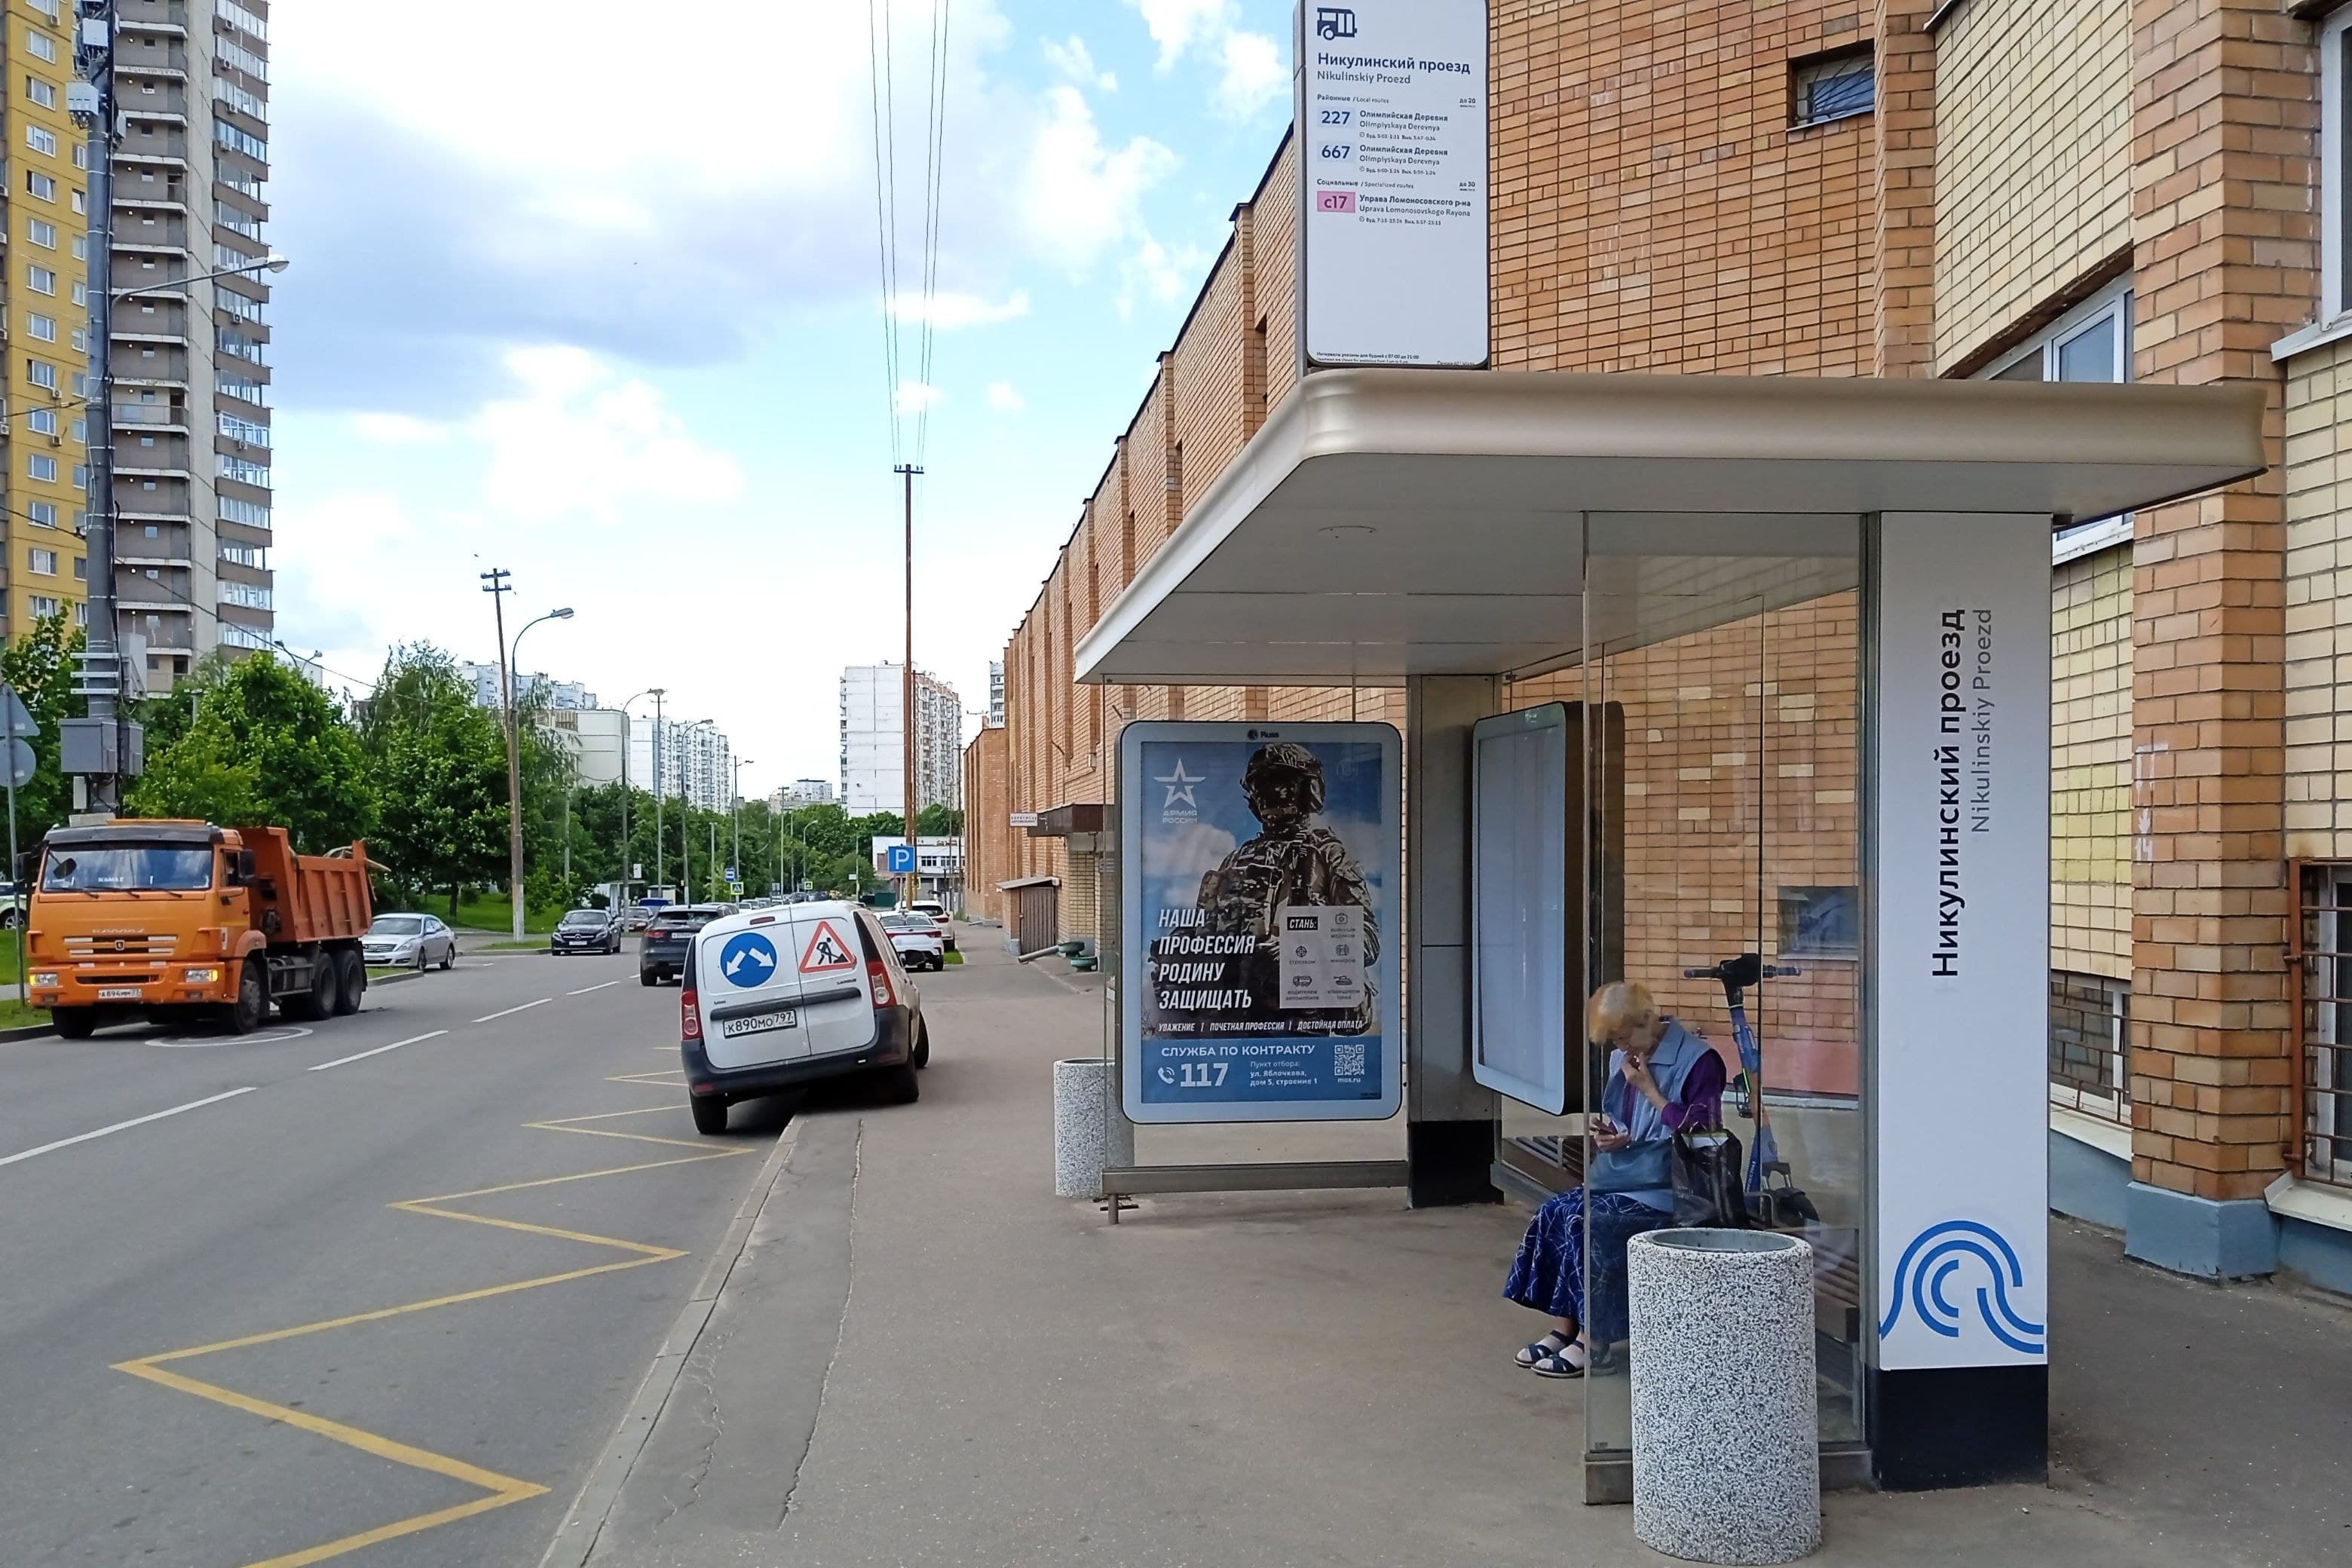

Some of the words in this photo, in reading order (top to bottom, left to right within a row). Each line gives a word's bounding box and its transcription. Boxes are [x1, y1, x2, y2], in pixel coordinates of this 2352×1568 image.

[1318, 52, 1415, 69] Никулинский
[1419, 60, 1471, 75] проезд
[1317, 70, 1374, 84] Nikulinskiy
[1377, 73, 1410, 84] Proezd
[1317, 93, 1351, 102] Районные
[1321, 110, 1351, 124] 227
[1359, 110, 1413, 121] Олимпийская
[1414, 112, 1448, 122] Деревня
[1408, 123, 1441, 132] Derevnya
[1321, 145, 1350, 159] 667
[1359, 145, 1413, 155] Олимпийская
[1414, 147, 1448, 156] Деревня
[1408, 157, 1441, 166] Derevnya
[1317, 179, 1358, 187] Социальные
[1359, 194, 1388, 204] Управа
[1389, 196, 1453, 206] Ломоносовского
[1359, 205, 1384, 213] Uprava
[1386, 207, 1444, 216] Lomonosovskogo
[1446, 209, 1471, 217] Rayona
[1972, 608, 1992, 690] Proezd
[1940, 609, 1966, 734] проезд
[1971, 697, 1995, 833] Nikulinskiy
[1931, 745, 1965, 977] Никулинский
[1159, 908, 1205, 927] НАША
[1289, 918, 1318, 929] СТАНЬ:
[1159, 935, 1256, 955] ПРОФЕССИЯ
[1159, 962, 1226, 984] РОДИНУ
[1159, 989, 1252, 1010] ЗАЩИЩАТЬ
[774, 1012, 792, 1024] 797
[1159, 1022, 1196, 1032] УВАЖЕНИЕ
[1209, 1021, 1244, 1031] ПОЧЕТНАЯ
[1245, 1021, 1285, 1031] ПРОФЕССИЯ
[1297, 1019, 1337, 1031] ДОСТОЙНАЯ
[1337, 1020, 1363, 1029] ОПЛАТА
[1162, 1046, 1216, 1057] СЛУЖБА
[1220, 1046, 1239, 1056] ПО
[1242, 1045, 1315, 1055] КОНТРАКТУ
[1180, 1062, 1229, 1087] 117
